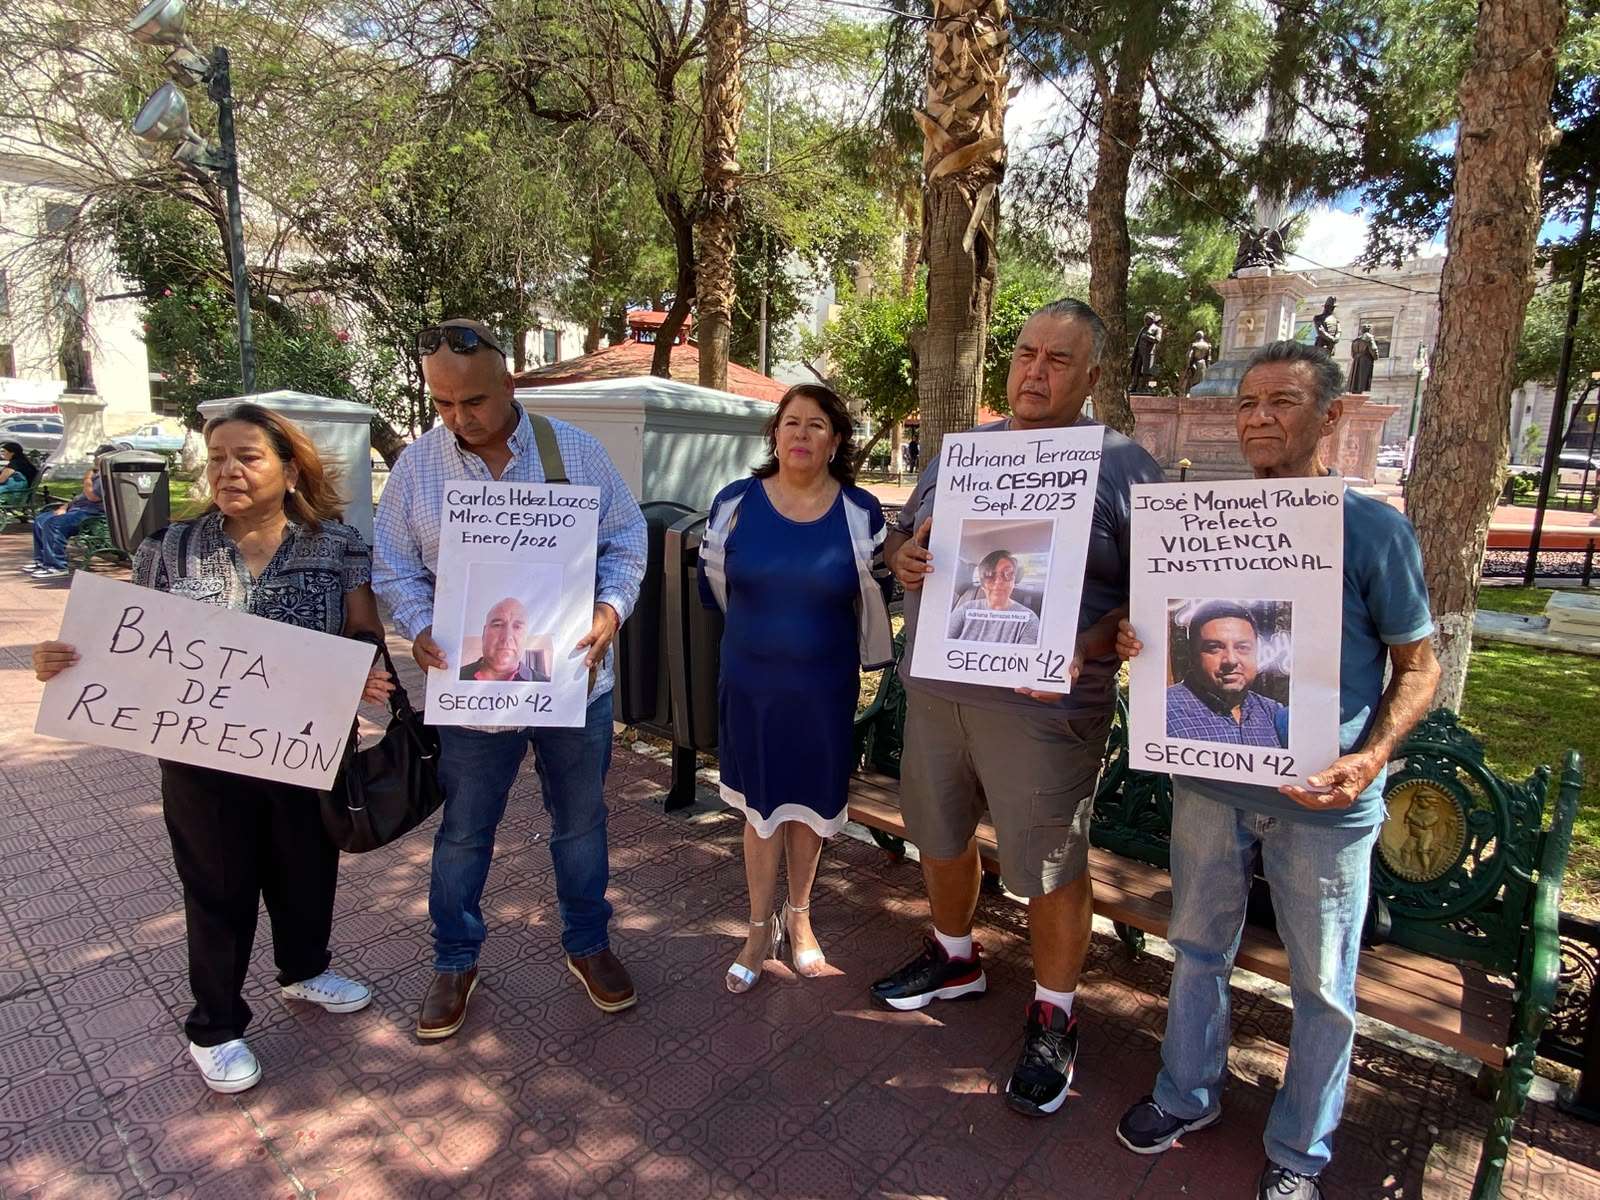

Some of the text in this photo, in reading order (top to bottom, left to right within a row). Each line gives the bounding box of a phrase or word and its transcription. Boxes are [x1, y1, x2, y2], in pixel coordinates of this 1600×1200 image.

[946, 439, 1102, 467] Adriana Terrazas
[996, 469, 1088, 490] CESADA
[447, 486, 506, 505] Carlos
[549, 490, 599, 510] Lazos
[1020, 492, 1077, 511] 2023
[1134, 488, 1339, 511] José Manuel Rubio
[495, 512, 576, 527] CESADO
[1180, 511, 1278, 531] Prefecto
[1160, 533, 1292, 553] VIOLENCIA
[1147, 554, 1332, 574] INSTITUCIONAL
[109, 606, 270, 688] BASTA
[1036, 650, 1065, 679] 42
[177, 678, 231, 709] DE
[525, 692, 553, 712] 42
[67, 683, 342, 772] REPRESIÓN
[1263, 755, 1298, 777] 42
